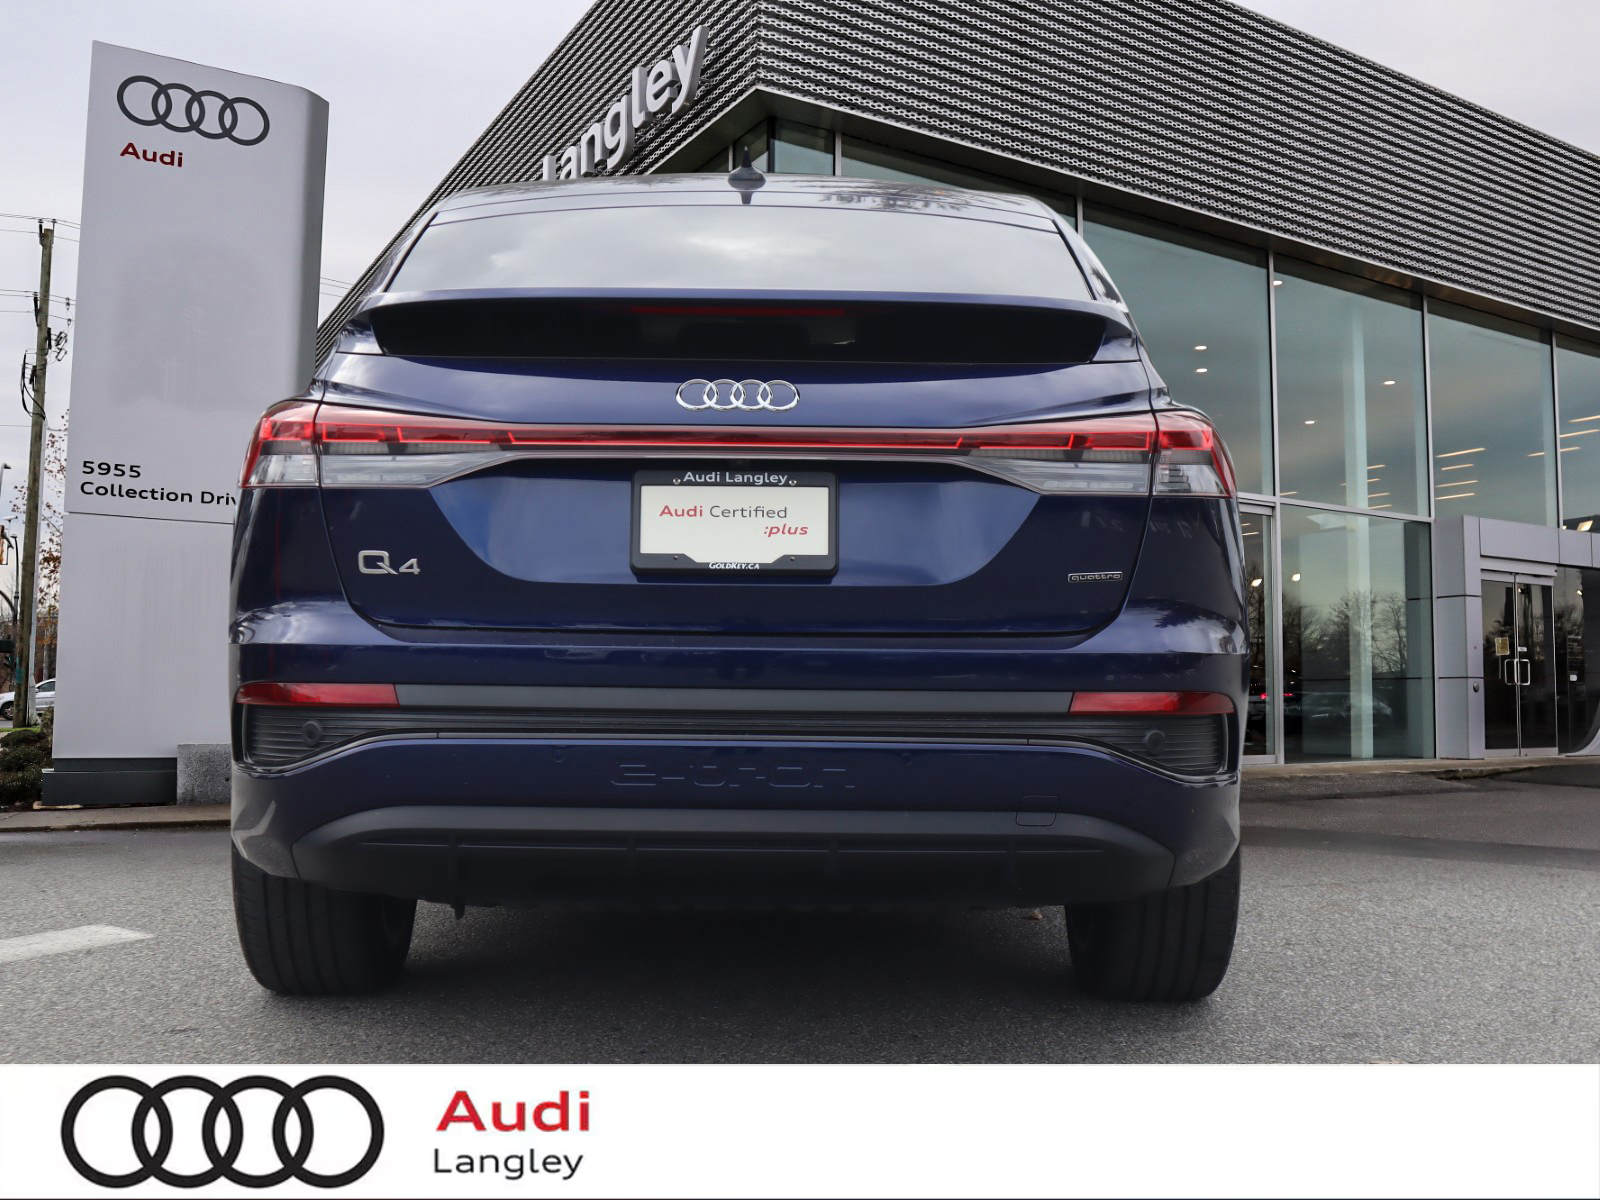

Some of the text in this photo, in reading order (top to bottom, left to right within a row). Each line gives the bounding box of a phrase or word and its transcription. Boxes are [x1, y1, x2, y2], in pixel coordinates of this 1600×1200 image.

[119, 142, 183, 168] Audi
[82, 460, 141, 478] 5955
[683, 471, 788, 486] Audi Langley
[80, 481, 193, 503] Collection
[659, 505, 788, 519] Audi Certified
[763, 523, 809, 538] :plus
[358, 549, 421, 575] Q4
[1071, 573, 1121, 582] quattro
